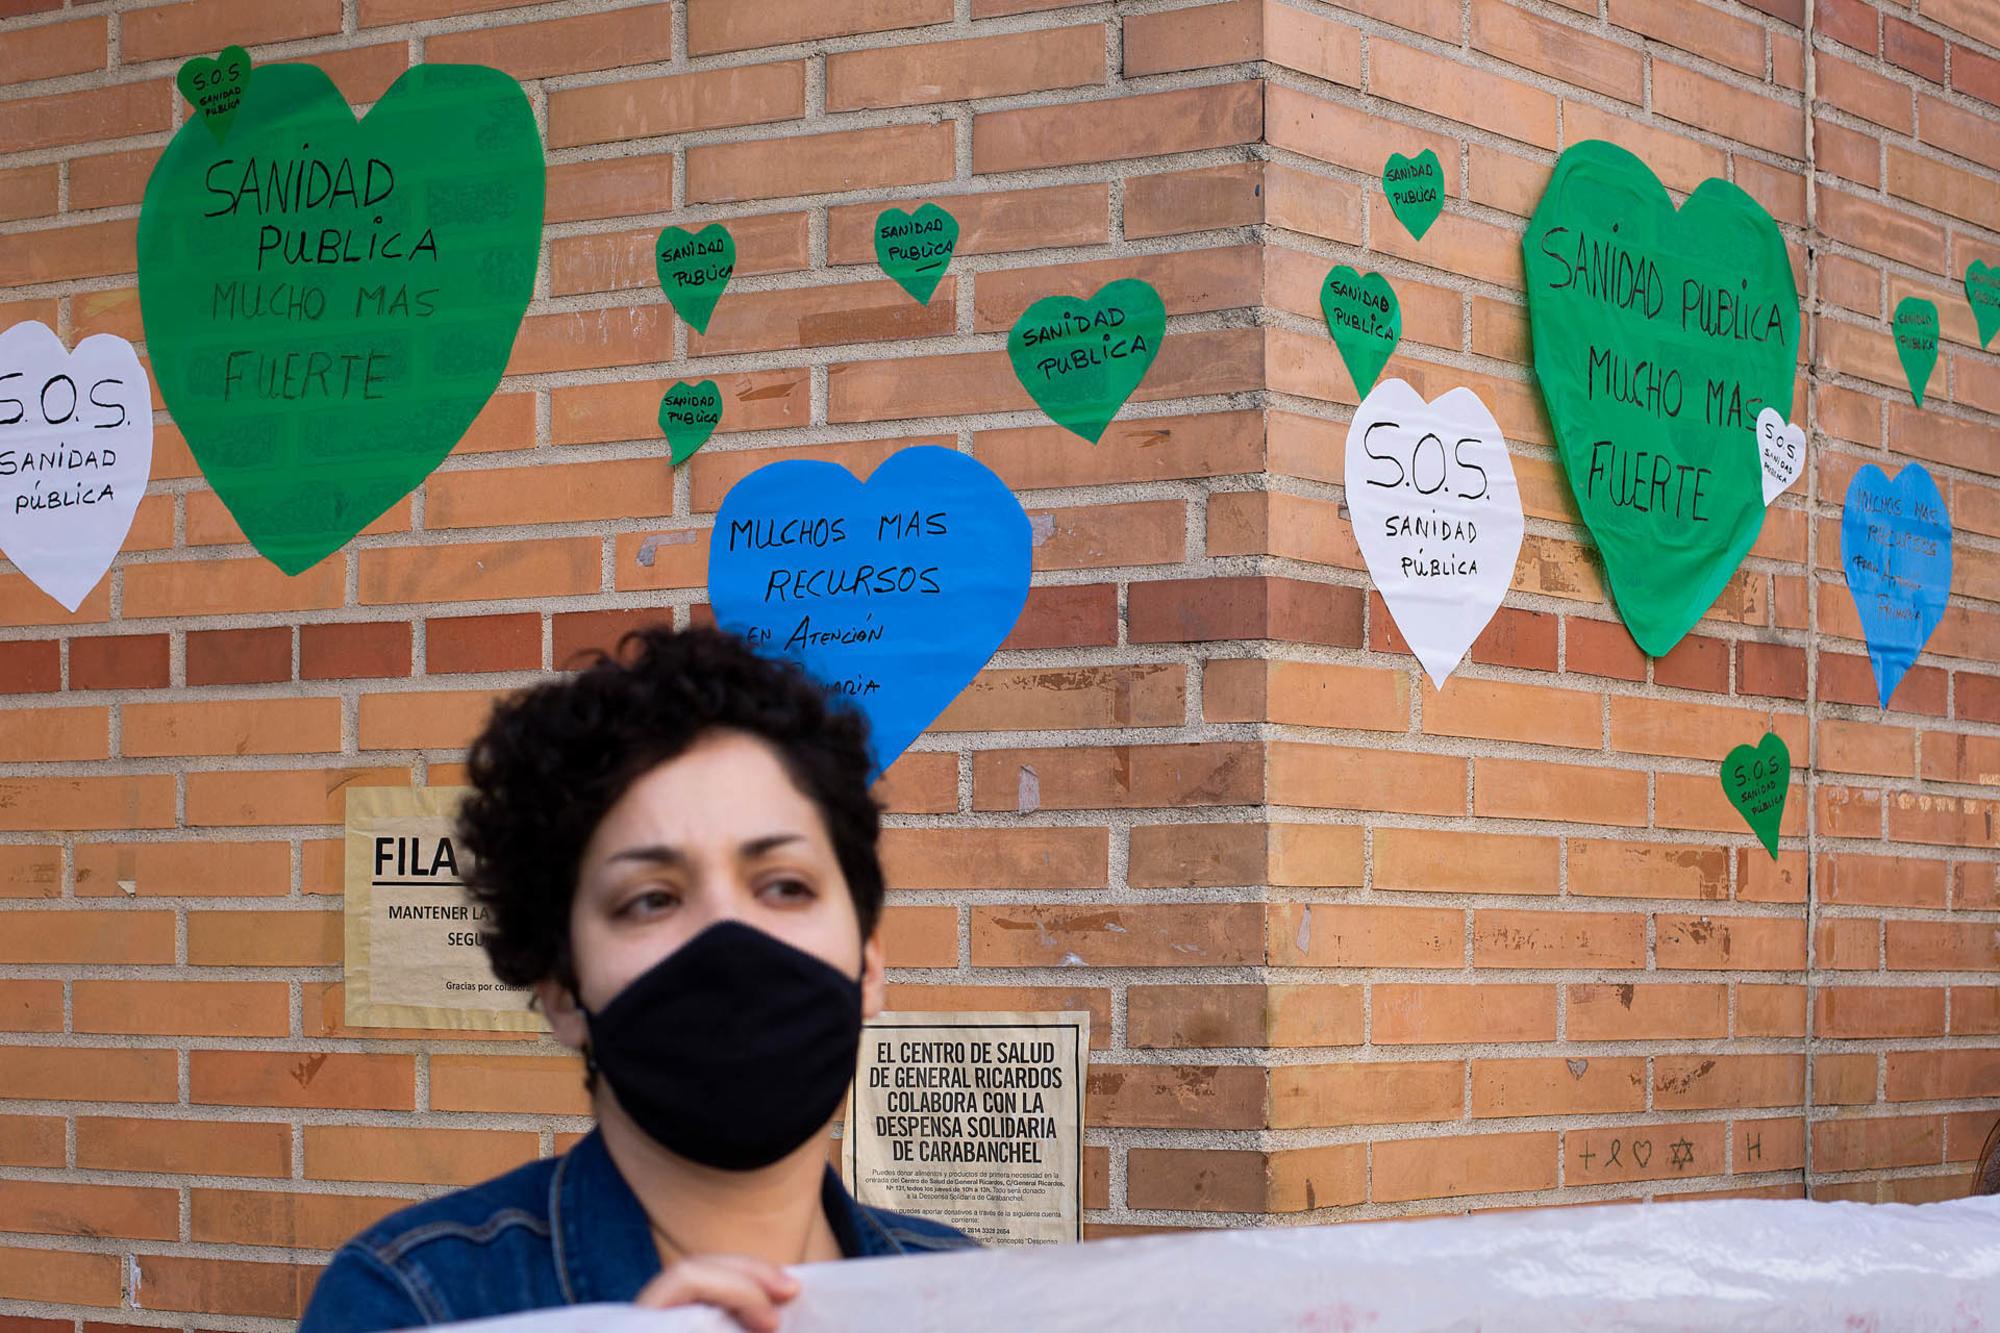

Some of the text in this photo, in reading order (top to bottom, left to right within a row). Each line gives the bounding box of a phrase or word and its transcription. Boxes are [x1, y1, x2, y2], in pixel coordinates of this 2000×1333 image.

[199, 86, 241, 106] SANIDAD
[204, 143, 394, 218] SANIDAD
[1386, 163, 1433, 182] SANIDAD
[257, 215, 438, 272] PUBLICA
[881, 218, 943, 239] SANIDAD
[661, 238, 724, 263] SANIDAD
[212, 281, 440, 321] MUCHO MAS
[1541, 223, 1785, 347] SANIDAD PUBLICA
[1022, 307, 1125, 347] SANIDAD
[1036, 333, 1147, 380] PUBLICA
[224, 350, 392, 401] FUERTE
[1588, 345, 1763, 433] MUCHO MAS
[663, 391, 715, 408] SANIDAD
[0, 441, 117, 476] SANIDAD
[1364, 422, 1491, 500] S.O.S.
[15, 480, 114, 515] PÚBLICA
[1587, 440, 1712, 522] FUERTE
[729, 510, 948, 552] MUCHOS MAS
[1385, 508, 1477, 544] SANIDAD
[1401, 547, 1478, 578] PÚBLICA
[764, 564, 942, 603] RECURSOS
[1741, 780, 1777, 804] SANIDAD
[374, 837, 461, 877] FILA
[388, 905, 469, 921] MANTENER
[446, 981, 476, 991] Gracias
[478, 983, 493, 993] por
[877, 1042, 1056, 1064] EL CENTRO DE SALUD
[869, 1066, 1064, 1090] DE GENERAL RICARDOS
[887, 1091, 1045, 1114] COLABORA CON LA
[875, 1116, 1057, 1140] DESPENSA SOLIDARIA
[892, 1140, 1043, 1164] DE CARABANCHEL
